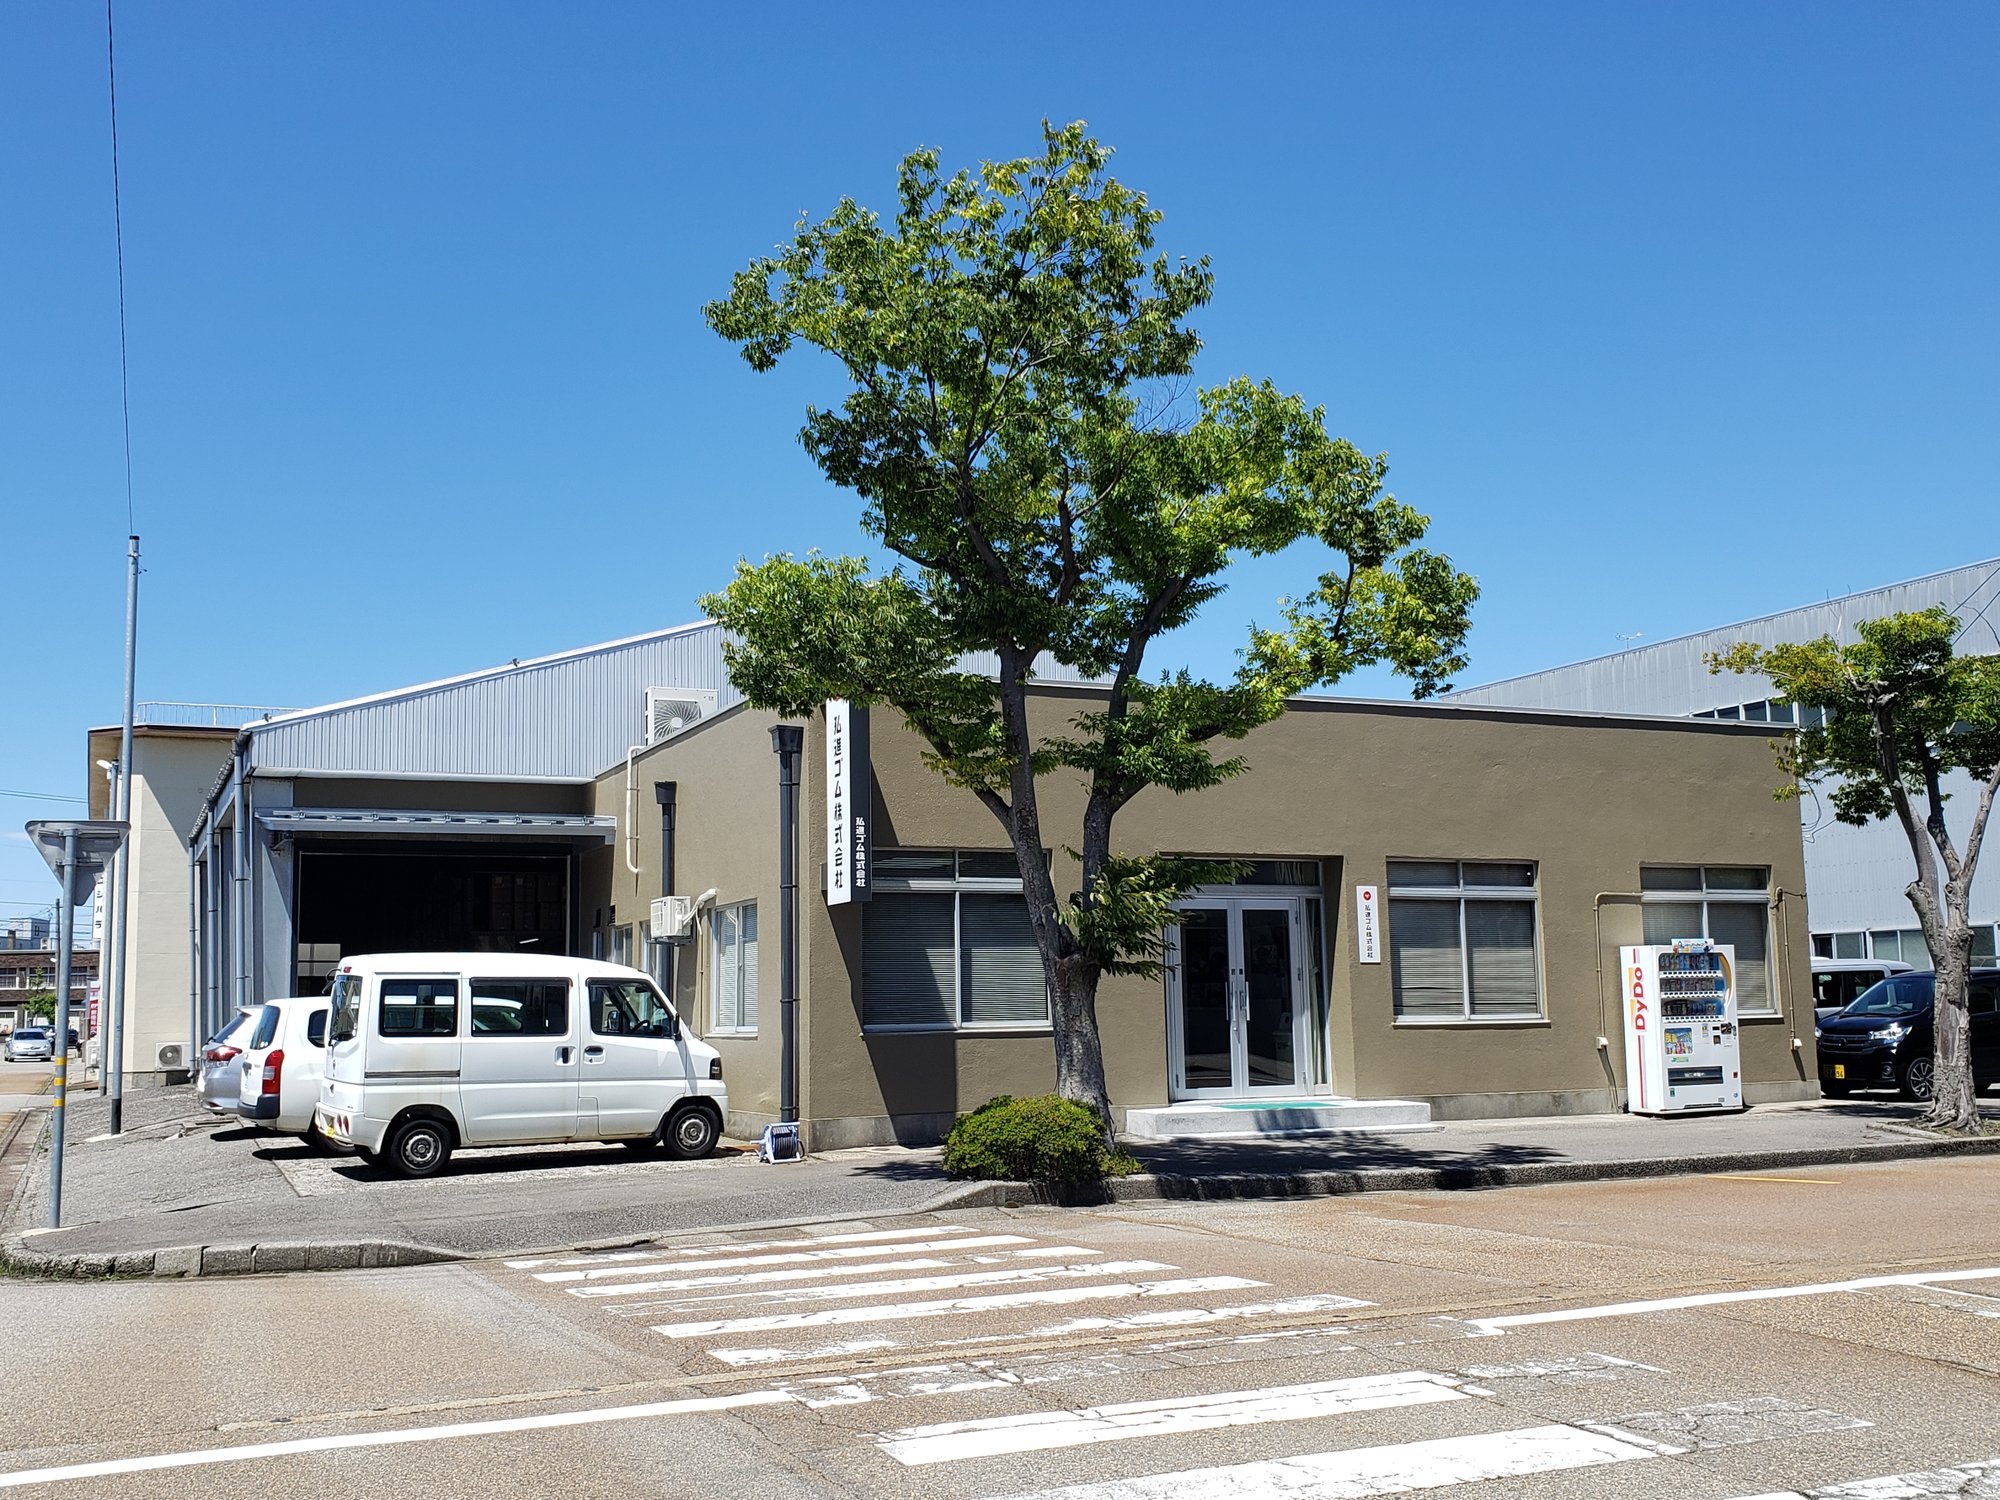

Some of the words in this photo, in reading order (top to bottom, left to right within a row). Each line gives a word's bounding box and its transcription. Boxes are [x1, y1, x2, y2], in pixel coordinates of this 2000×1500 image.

[833, 715, 843, 889] 弘進ゴム株式会社
[855, 816, 866, 887] 弘進ゴム株式会社
[1633, 966, 1648, 1030] DyDo
